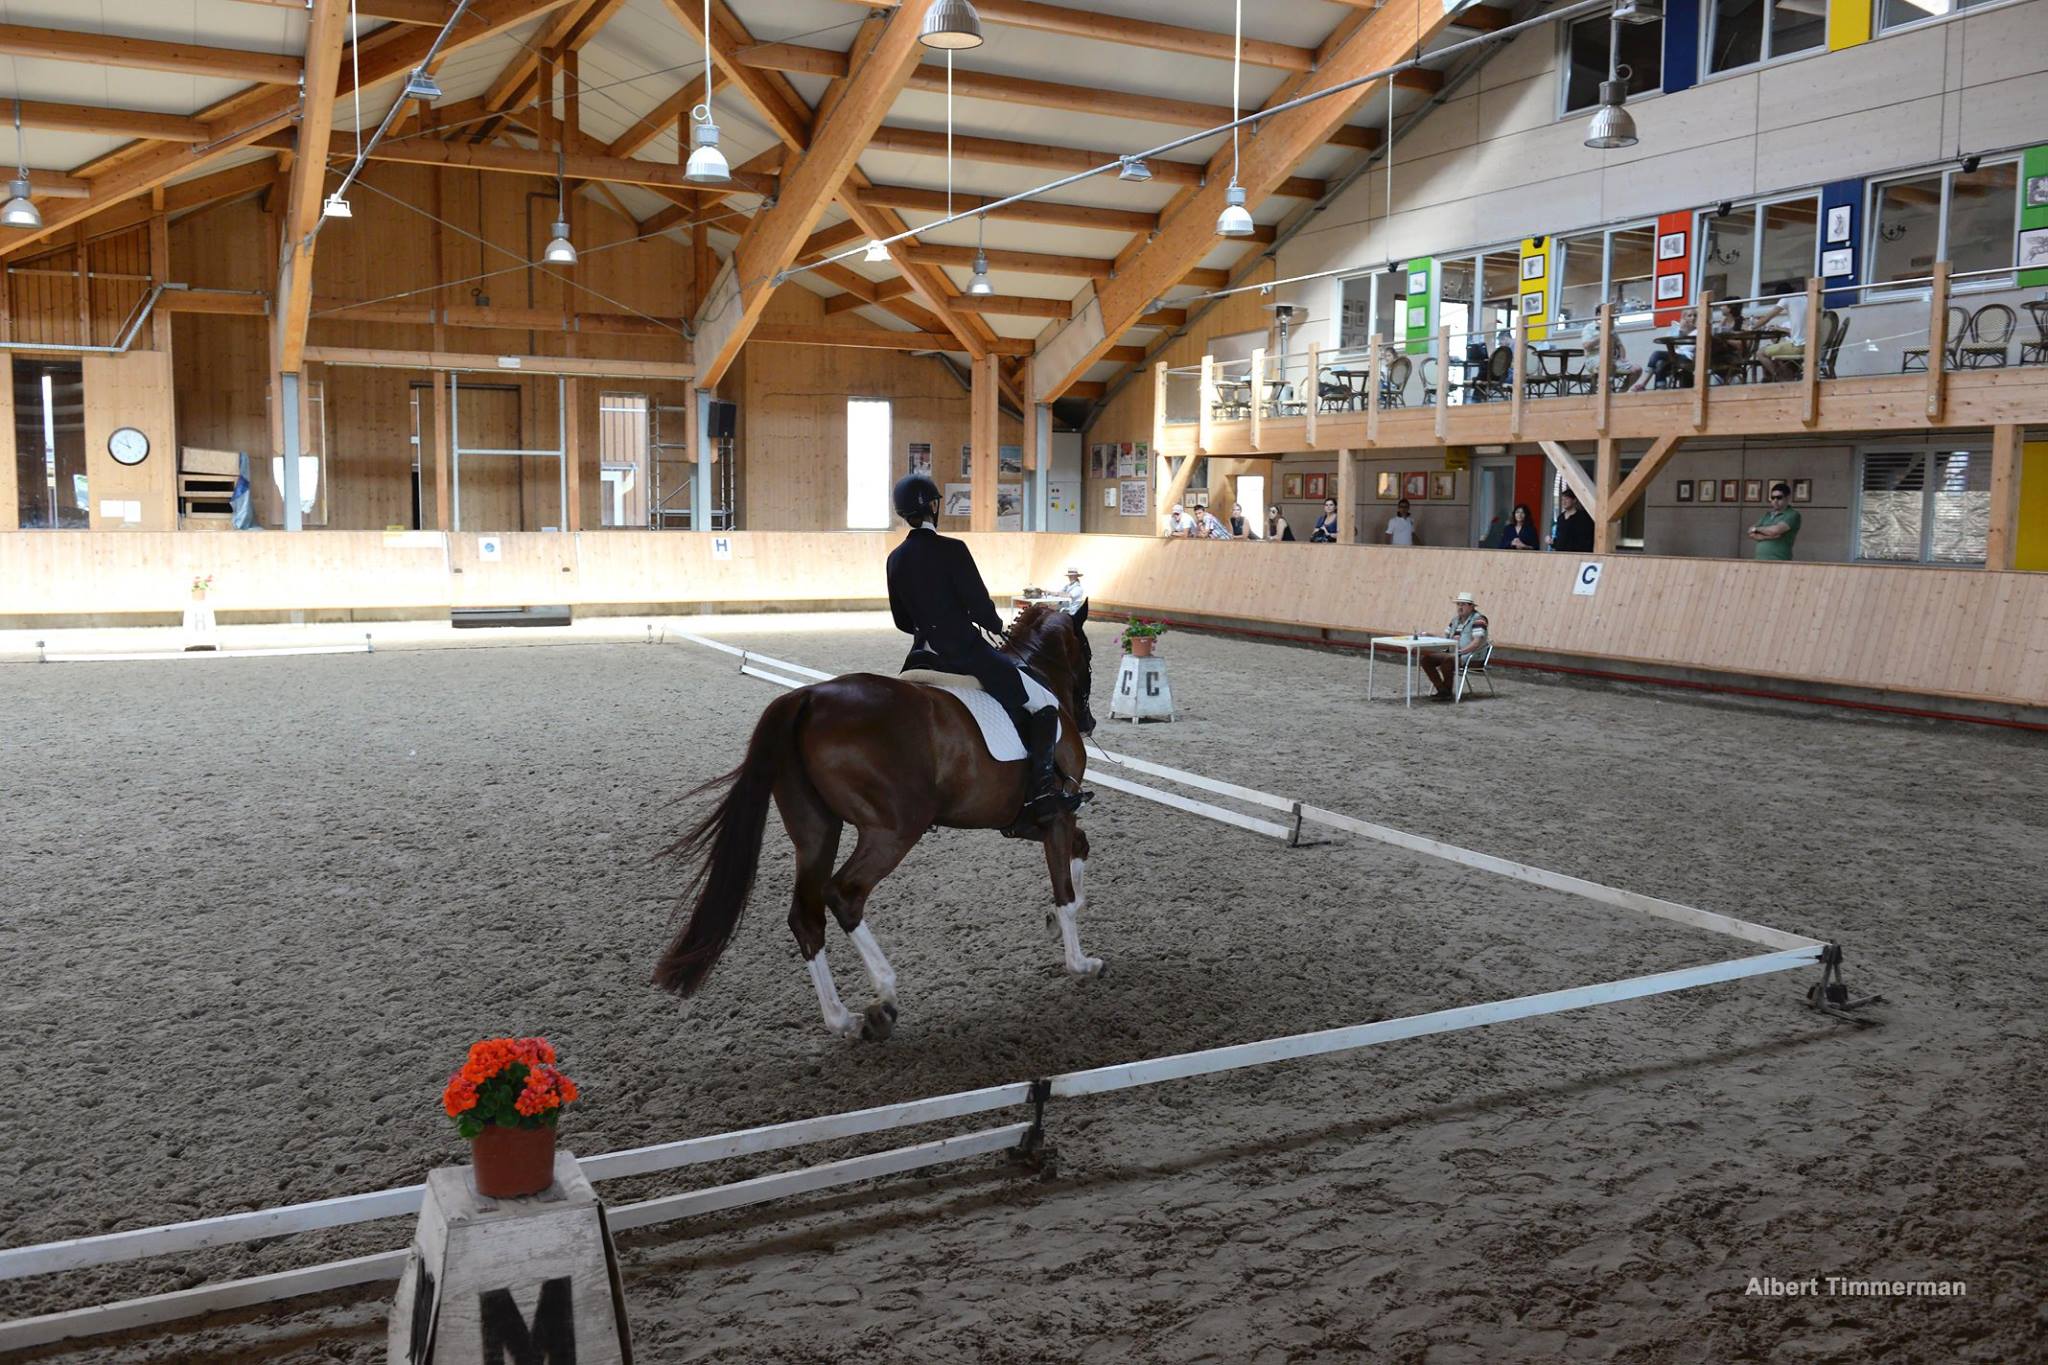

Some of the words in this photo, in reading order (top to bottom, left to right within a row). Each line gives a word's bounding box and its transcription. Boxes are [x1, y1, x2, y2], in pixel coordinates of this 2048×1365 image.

[715, 539, 728, 552] H
[1582, 565, 1598, 585] C
[1121, 670, 1133, 696] C
[1146, 671, 1160, 697] C
[479, 1275, 577, 1365] M
